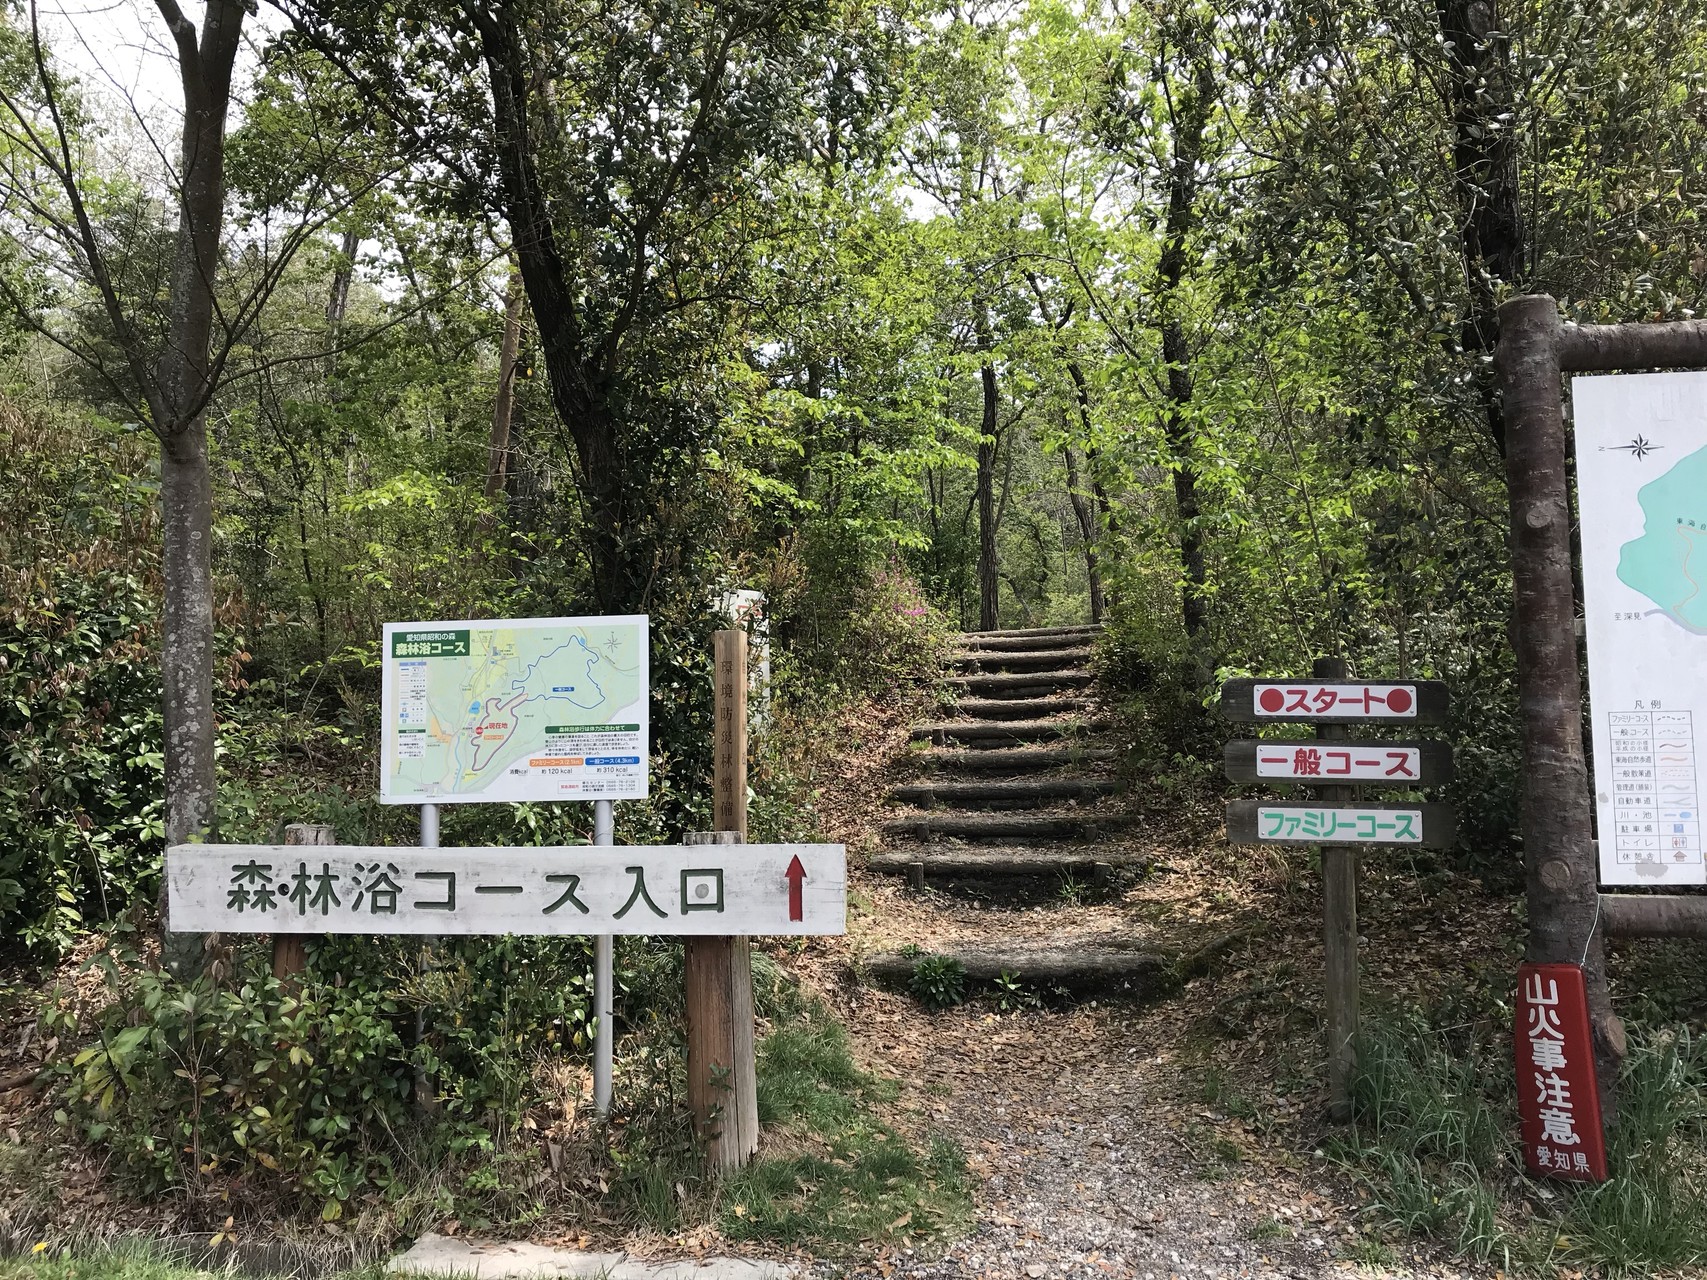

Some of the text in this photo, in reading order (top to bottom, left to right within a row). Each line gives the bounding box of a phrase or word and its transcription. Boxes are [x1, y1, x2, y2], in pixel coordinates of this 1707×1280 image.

[1614, 612, 1641, 621] 至深見
[406, 632, 456, 642] 愛知県昭和の森
[395, 642, 466, 656] 森林浴コース
[1634, 700, 1661, 710] 凡例
[1612, 715, 1650, 724] ファミリーコース
[489, 722, 508, 730] 現在地
[1613, 728, 1650, 737] 一般コース
[720, 660, 733, 831] 環境防災林整備
[1261, 748, 1414, 777] 一般コース
[1616, 756, 1653, 764] 東海自然歩道
[1618, 797, 1652, 805] 自動車道
[1264, 812, 1417, 839] ファミリーコース
[1621, 825, 1654, 834] 駐車場
[1622, 839, 1654, 847] トイレ
[226, 858, 725, 920] 森林浴コース入口
[1525, 973, 1581, 1145] 山火事注意
[1536, 1146, 1590, 1173] 愛知県
